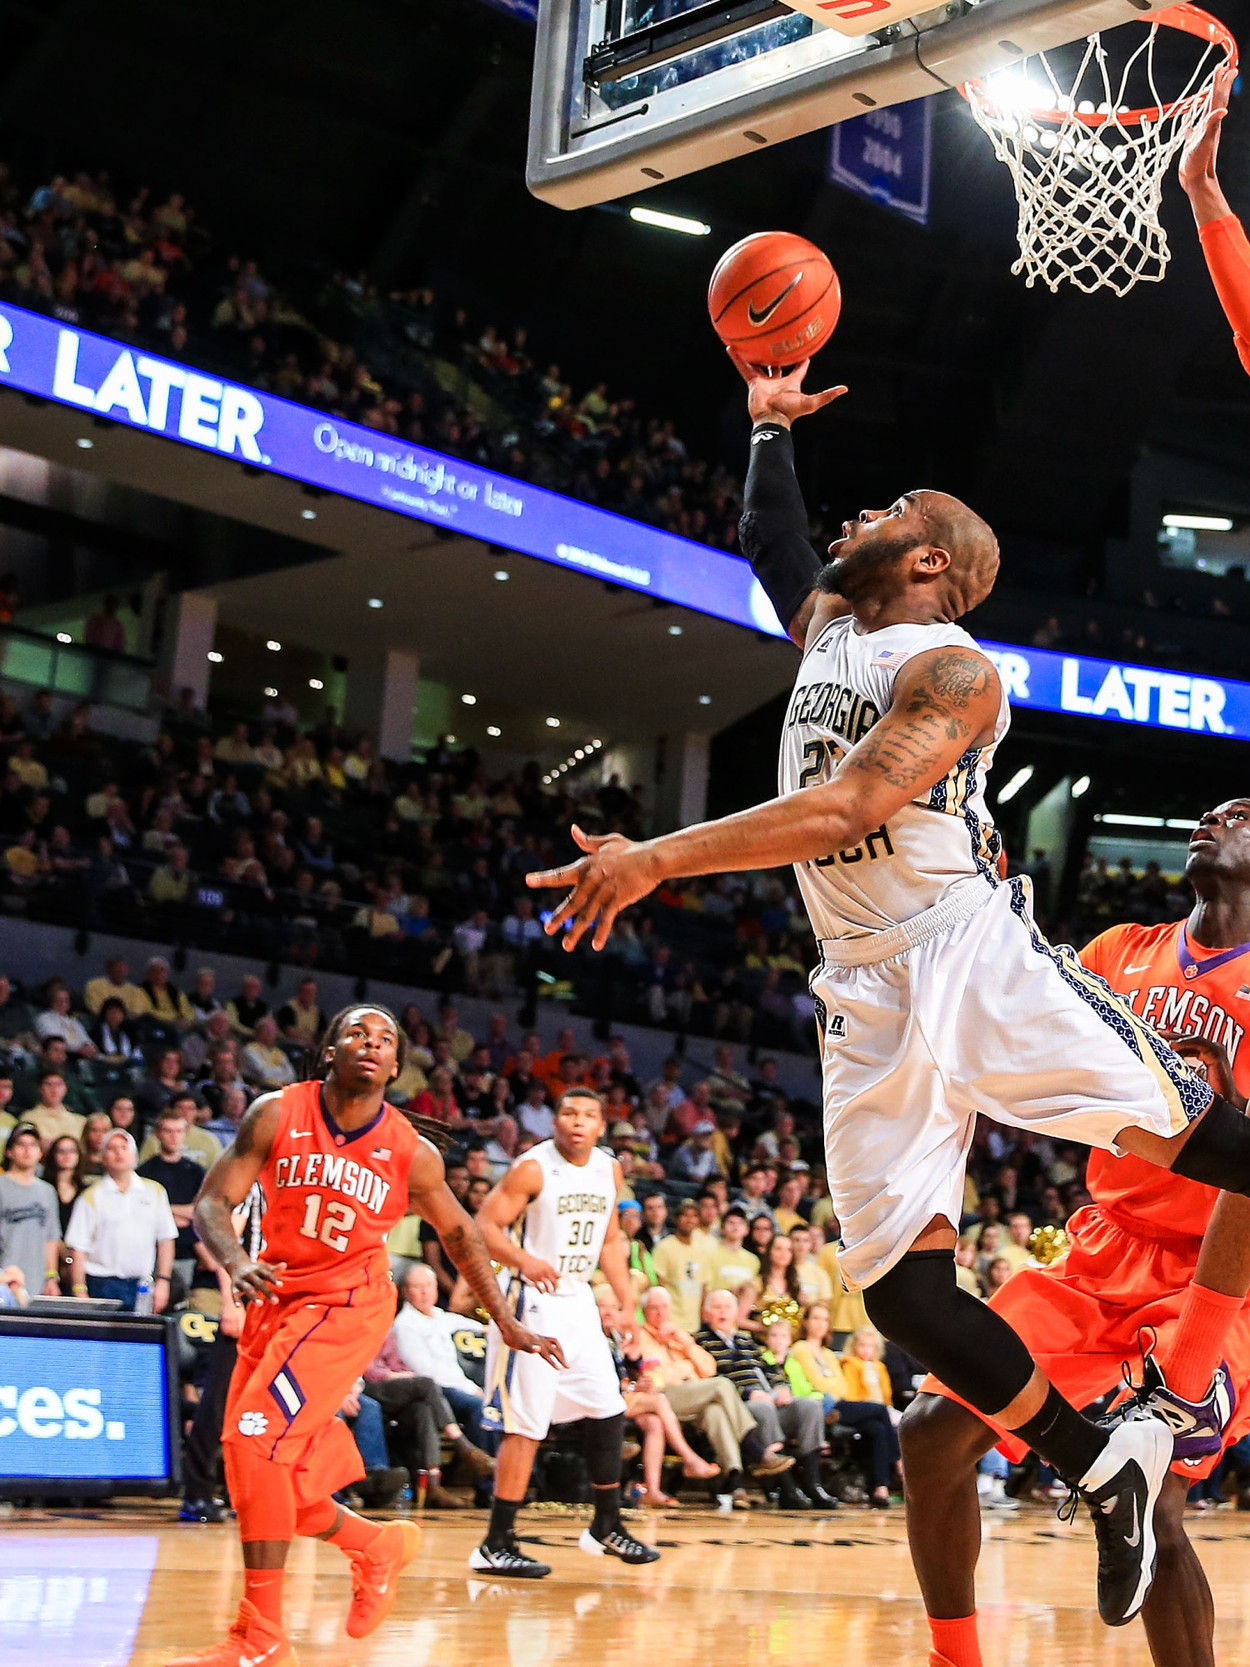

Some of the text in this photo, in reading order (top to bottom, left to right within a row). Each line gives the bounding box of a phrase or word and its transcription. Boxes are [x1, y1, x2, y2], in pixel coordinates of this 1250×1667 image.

[275, 1152, 391, 1215] CLEMSON
[300, 1192, 357, 1253] 12
[568, 1220, 595, 1246] 30
